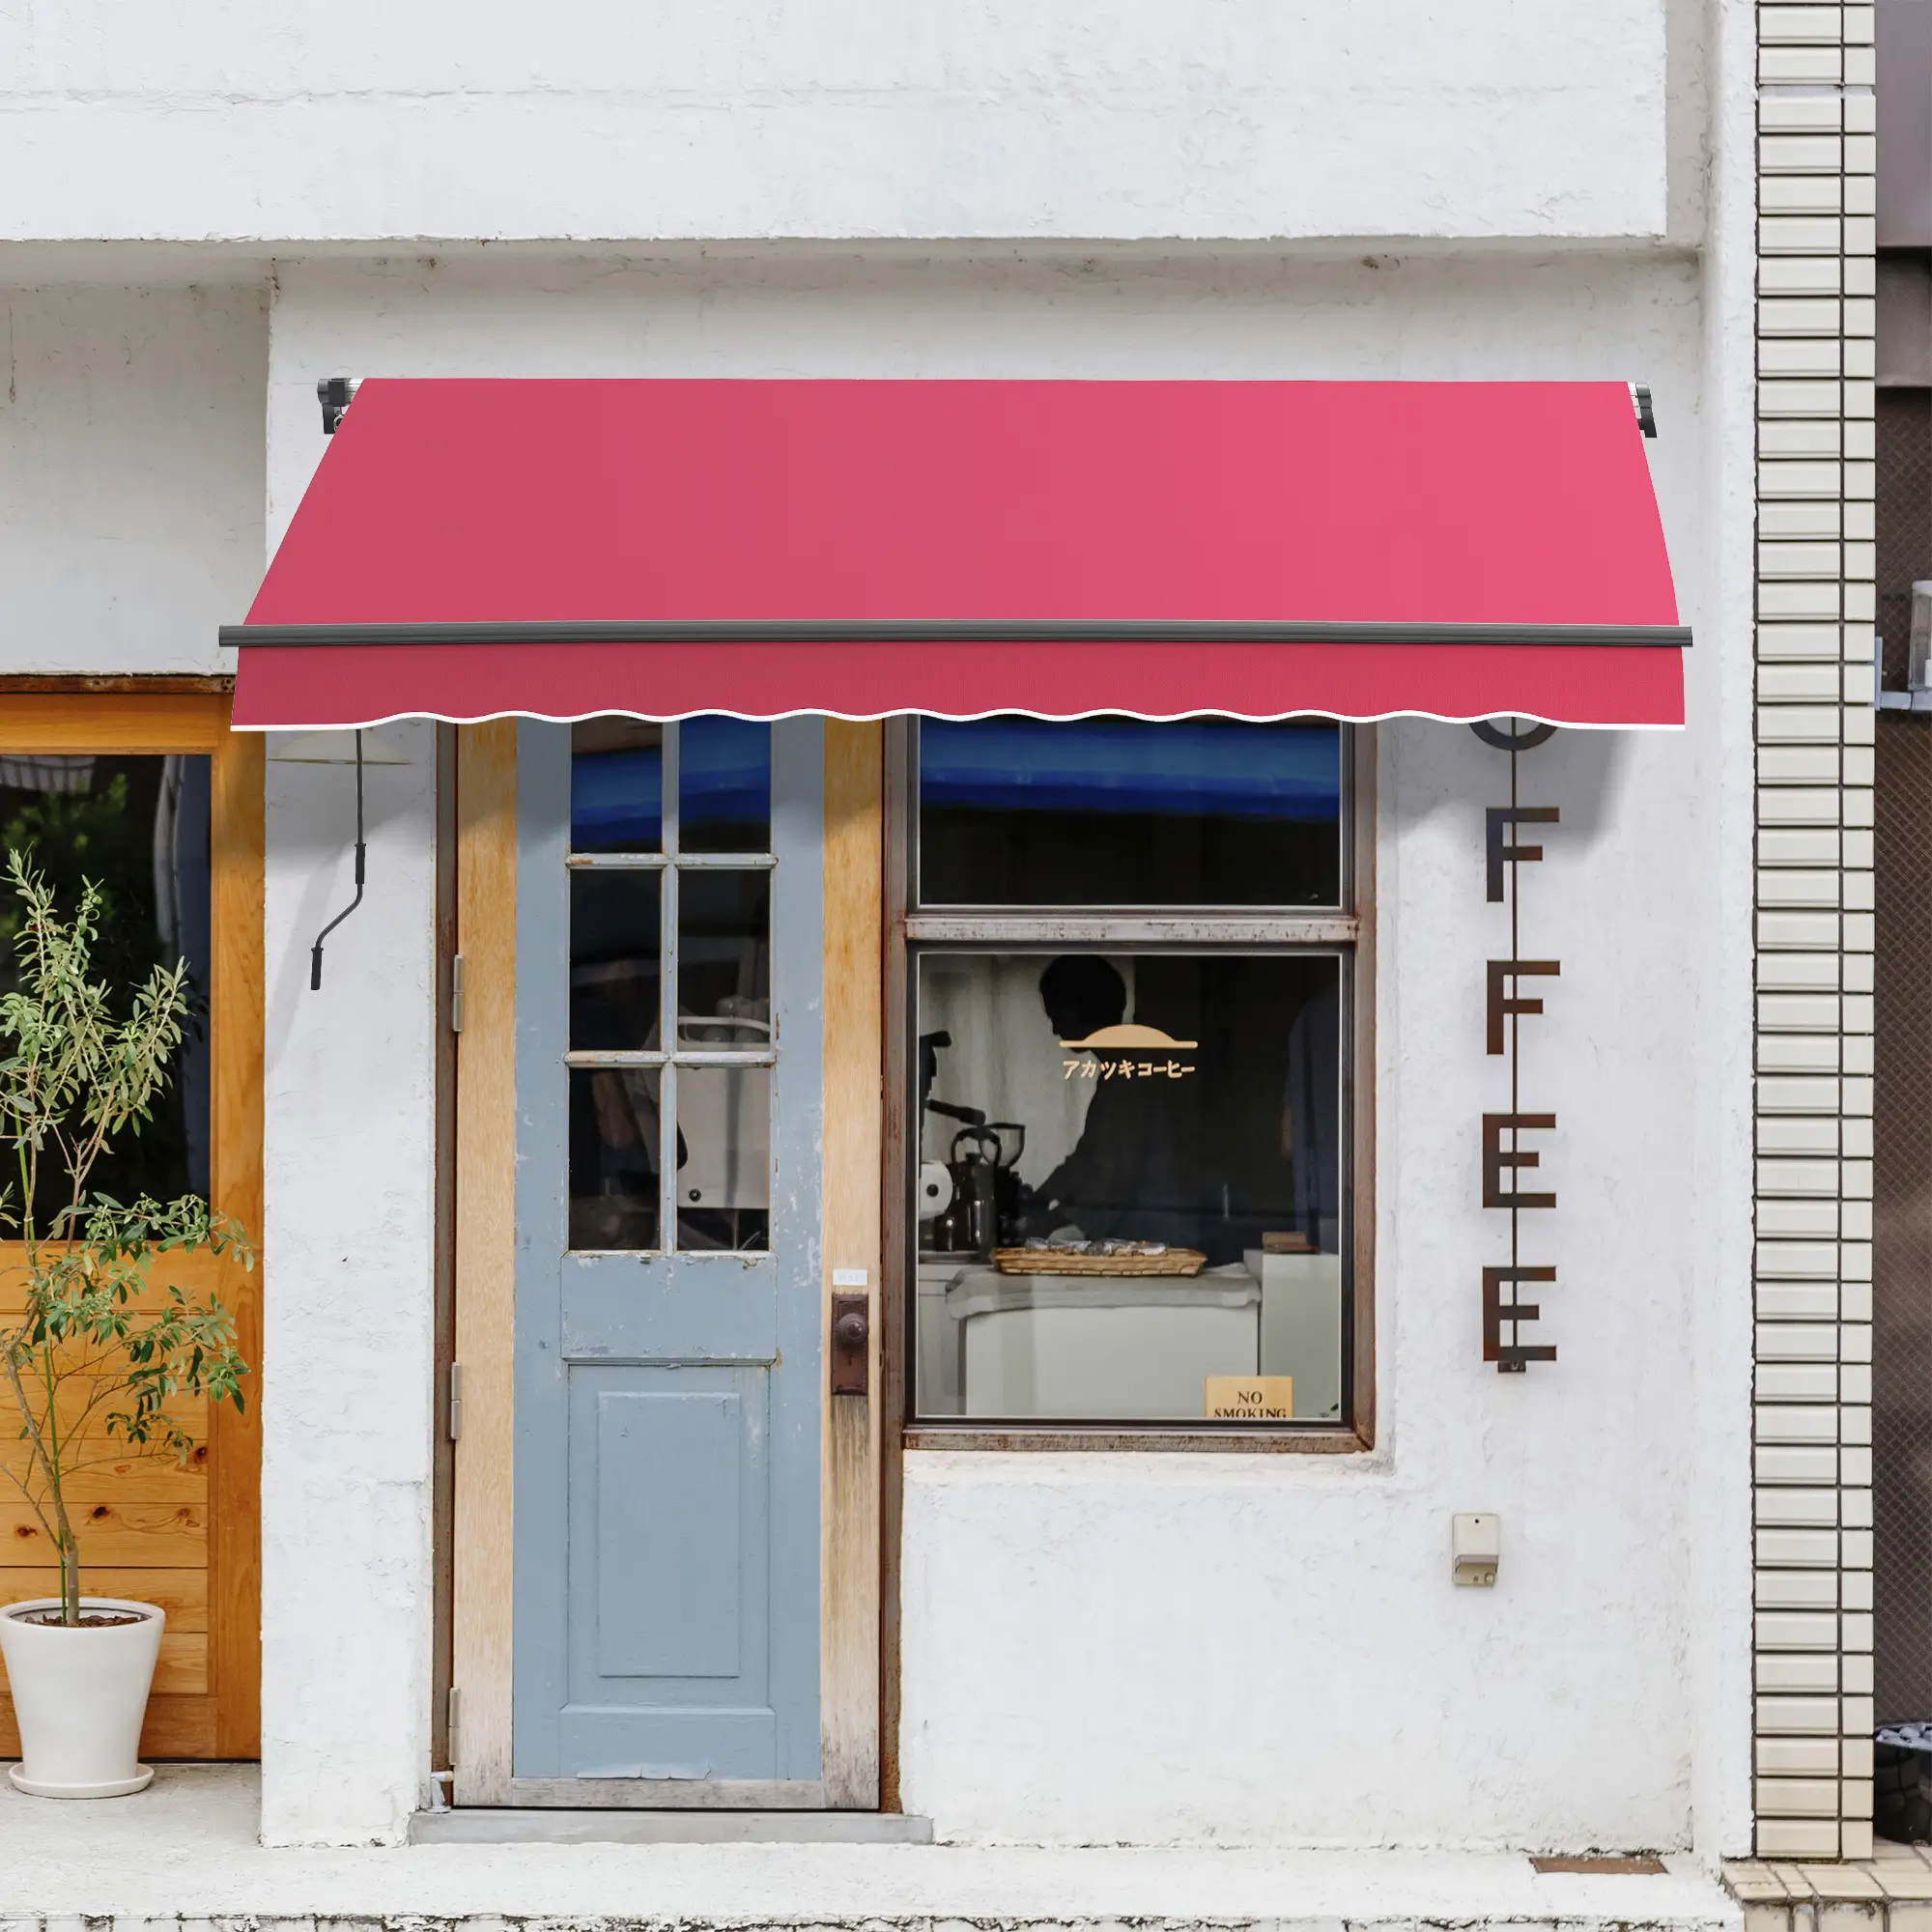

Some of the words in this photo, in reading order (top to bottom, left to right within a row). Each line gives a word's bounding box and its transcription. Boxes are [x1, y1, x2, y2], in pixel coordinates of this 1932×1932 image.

[1063, 1060, 1196, 1081] アカツキコーヒー
[1236, 1391, 1264, 1405] NO
[1213, 1407, 1288, 1418] SMOKING
